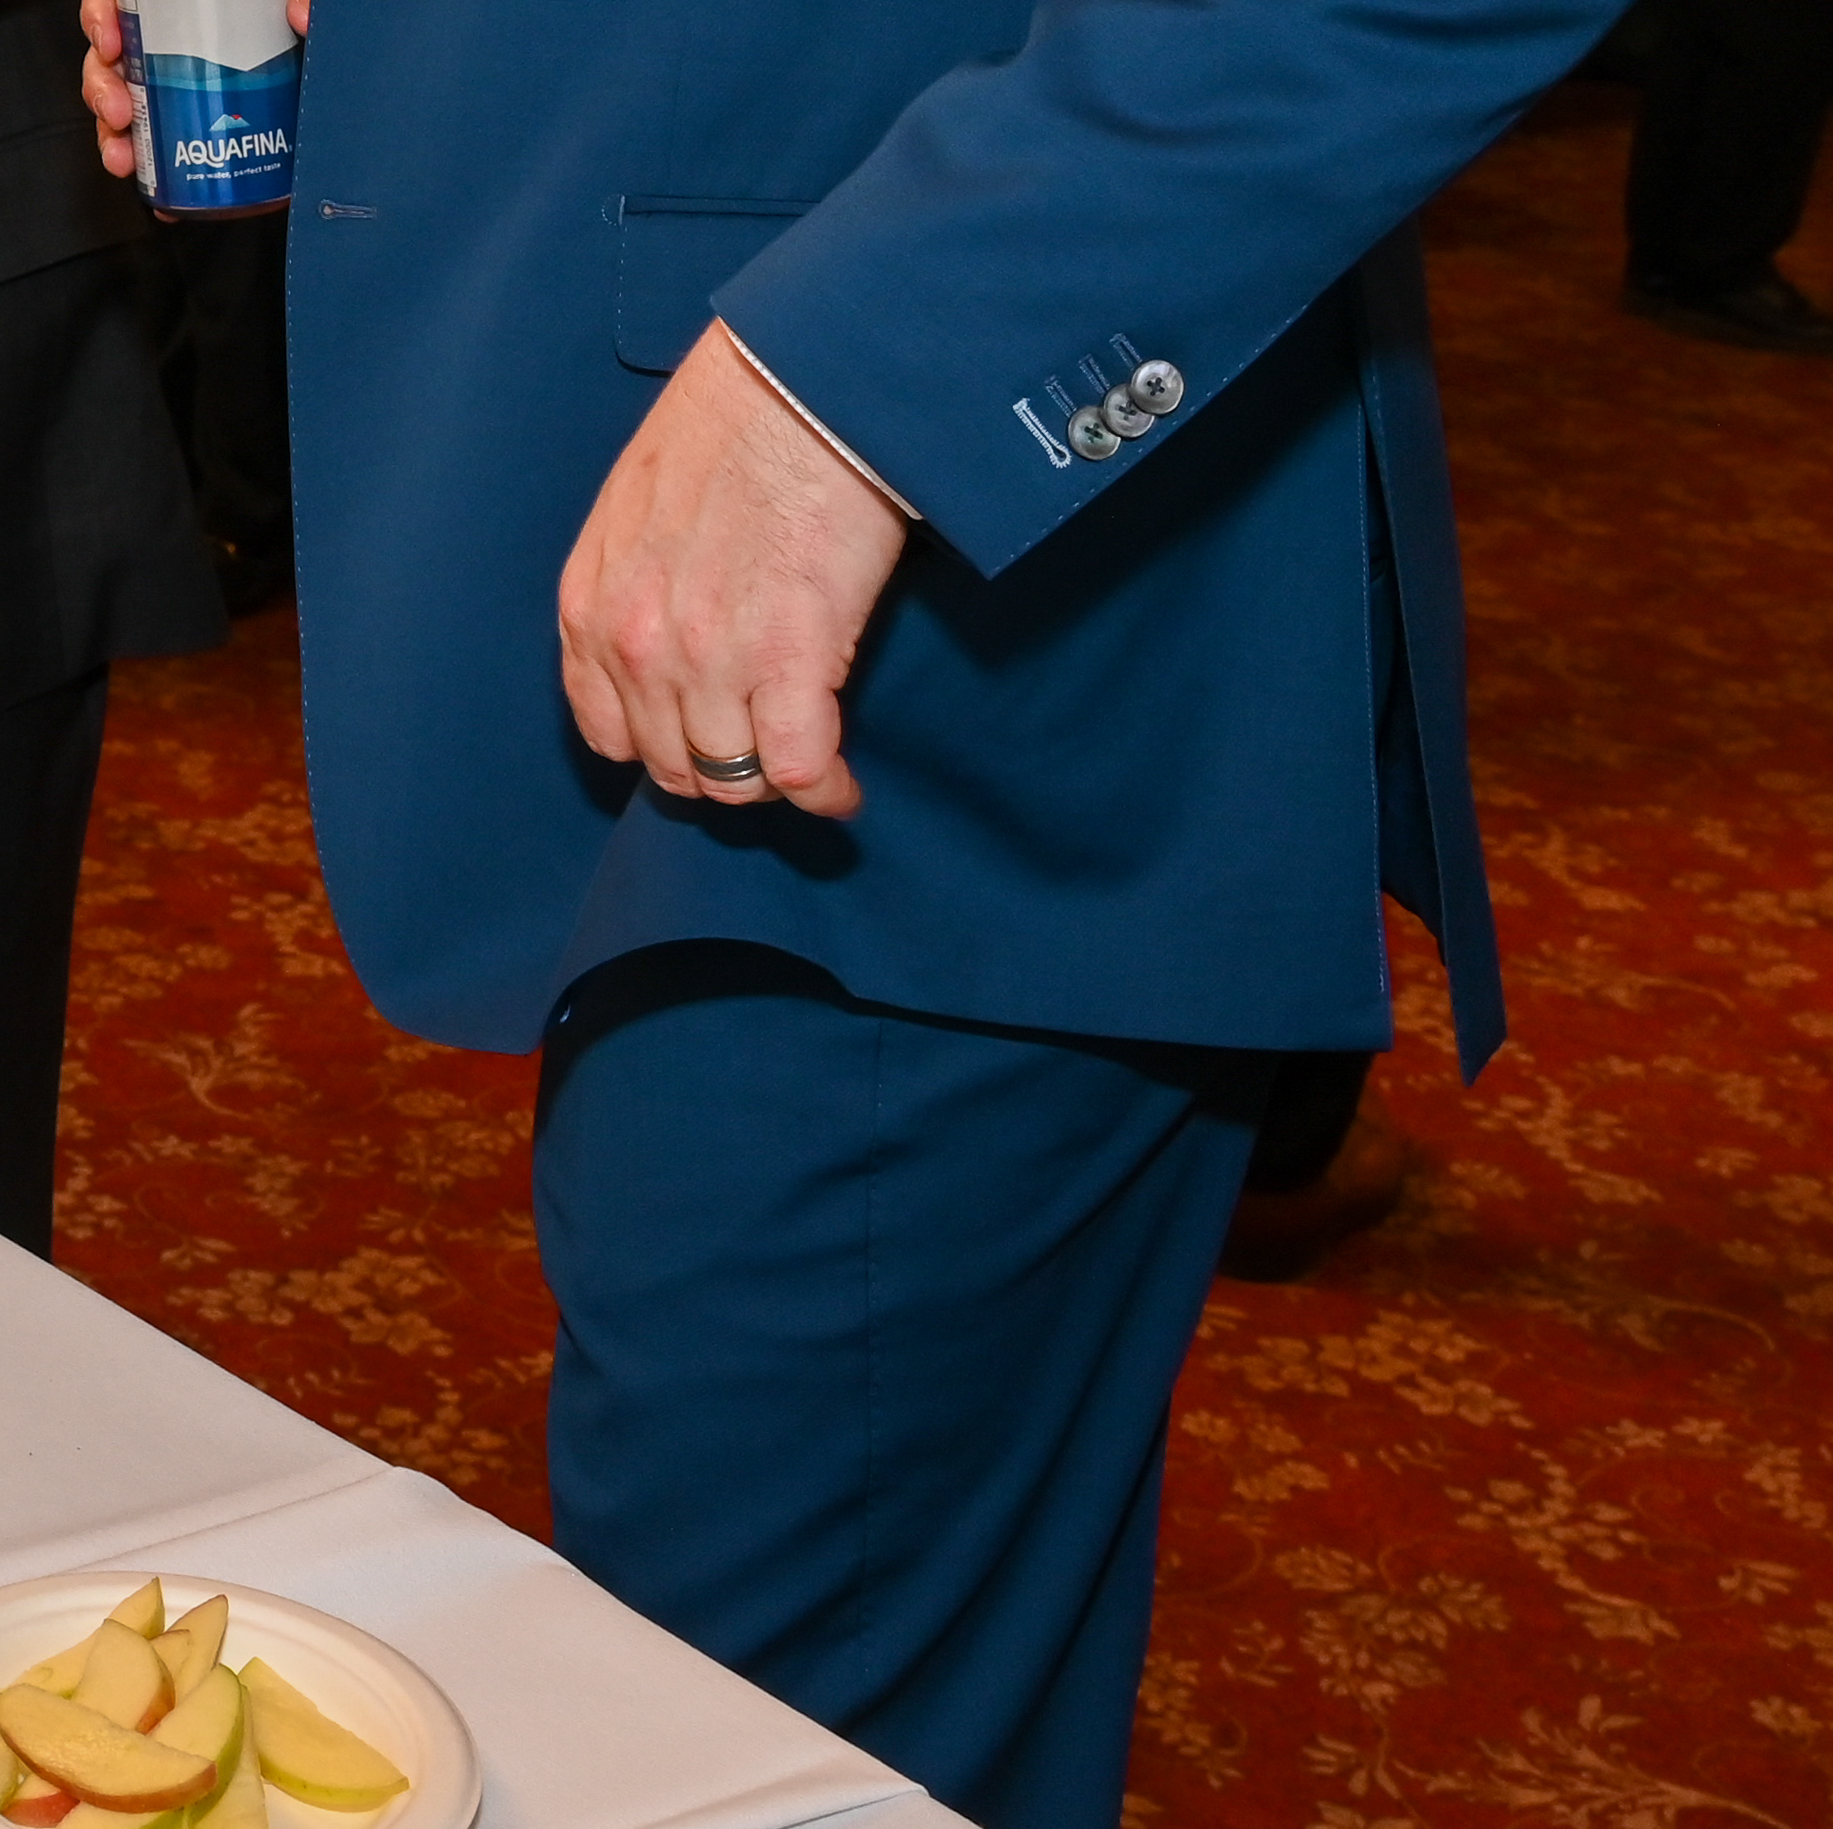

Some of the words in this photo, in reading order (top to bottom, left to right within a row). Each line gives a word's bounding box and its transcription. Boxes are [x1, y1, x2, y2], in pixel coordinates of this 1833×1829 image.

[174, 128, 288, 168] AQUAFINA
[234, 168, 262, 178] perfect
[263, 162, 281, 173] taste
